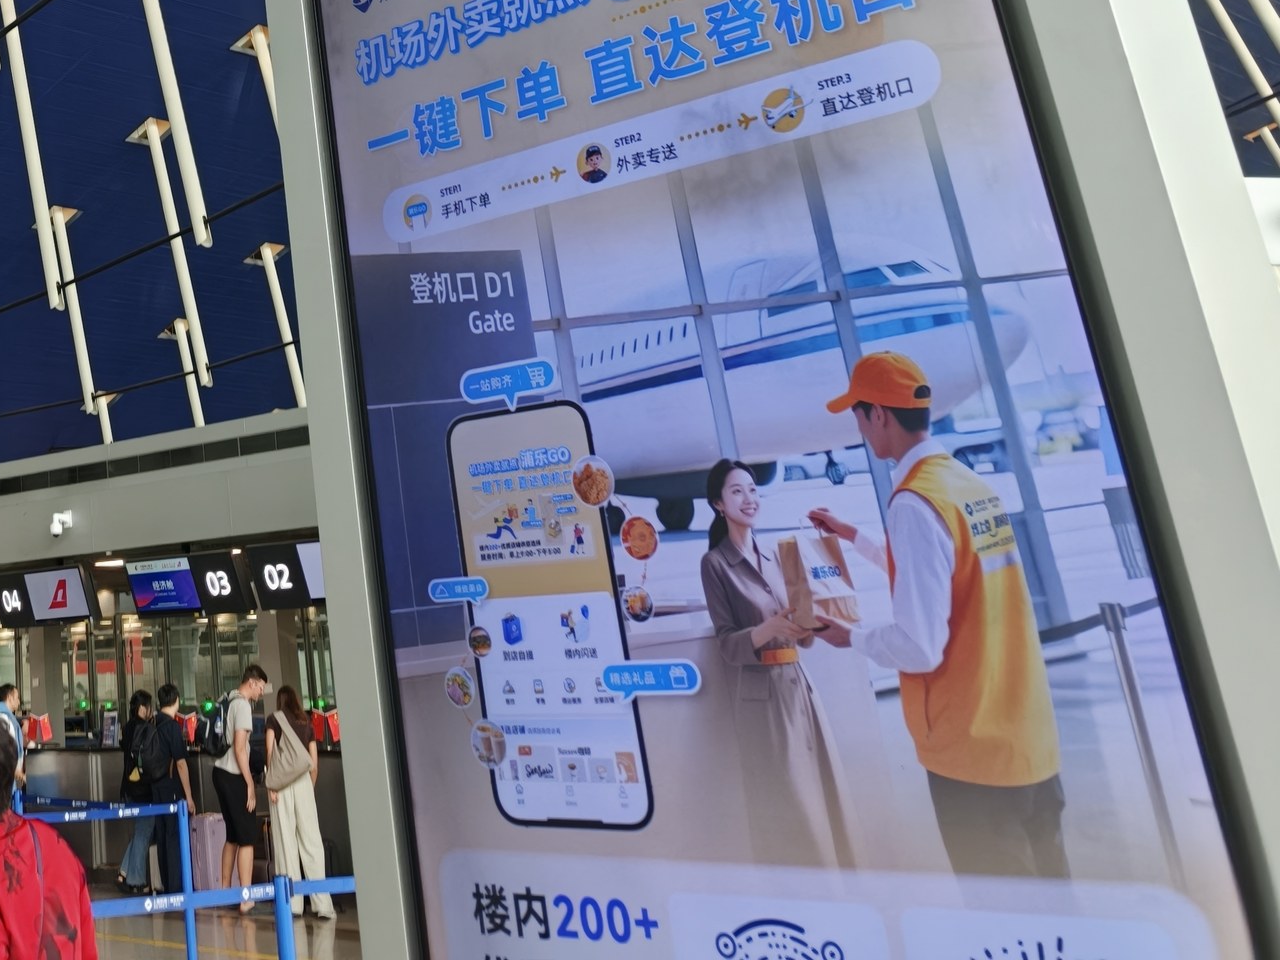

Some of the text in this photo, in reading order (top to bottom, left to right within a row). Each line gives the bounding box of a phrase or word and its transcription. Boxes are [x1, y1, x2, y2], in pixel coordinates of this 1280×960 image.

[367, 59, 568, 157] 一键下单
[820, 76, 915, 117] 直达登机口
[616, 142, 679, 174] 外卖专送
[441, 192, 492, 219] 手机下单
[410, 270, 516, 305] 登机口 D1
[468, 309, 516, 335] Gate
[469, 373, 513, 392] 一站购齐
[205, 571, 231, 597] 03
[264, 563, 293, 591] 02
[2, 589, 21, 613] 04
